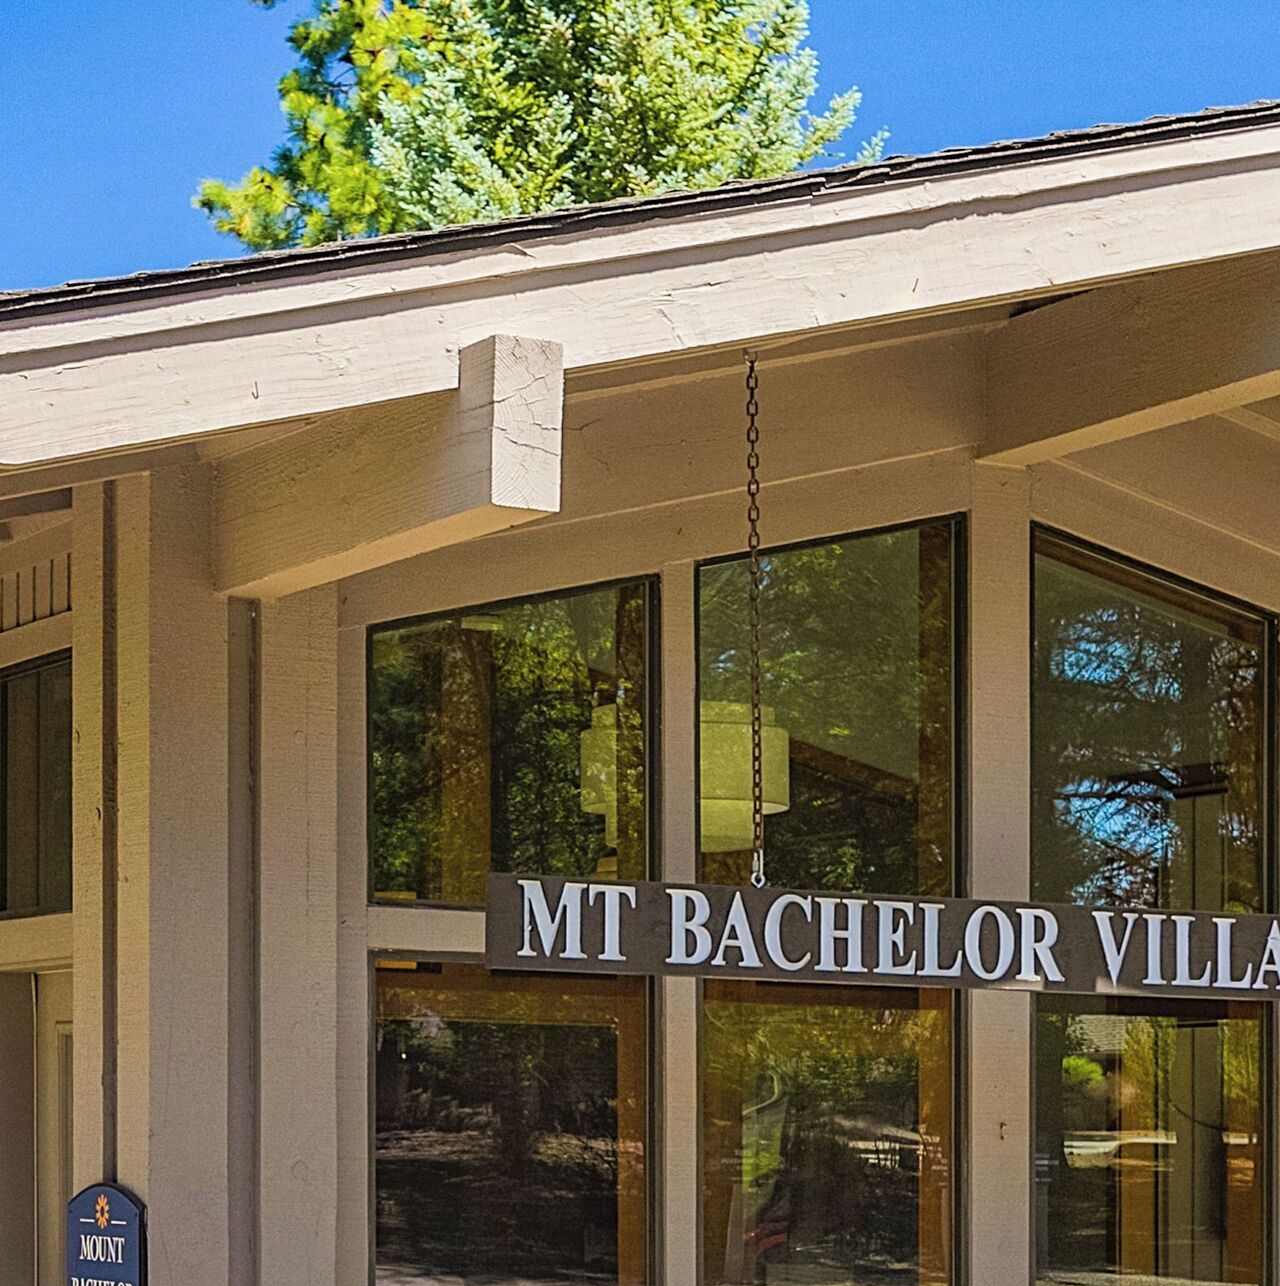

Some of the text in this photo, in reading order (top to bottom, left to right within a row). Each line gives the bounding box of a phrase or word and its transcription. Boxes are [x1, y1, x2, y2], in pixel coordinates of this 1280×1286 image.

[517, 879, 637, 961] MT
[665, 888, 1066, 983] BACHELOR
[79, 1234, 125, 1264] MOUNT
